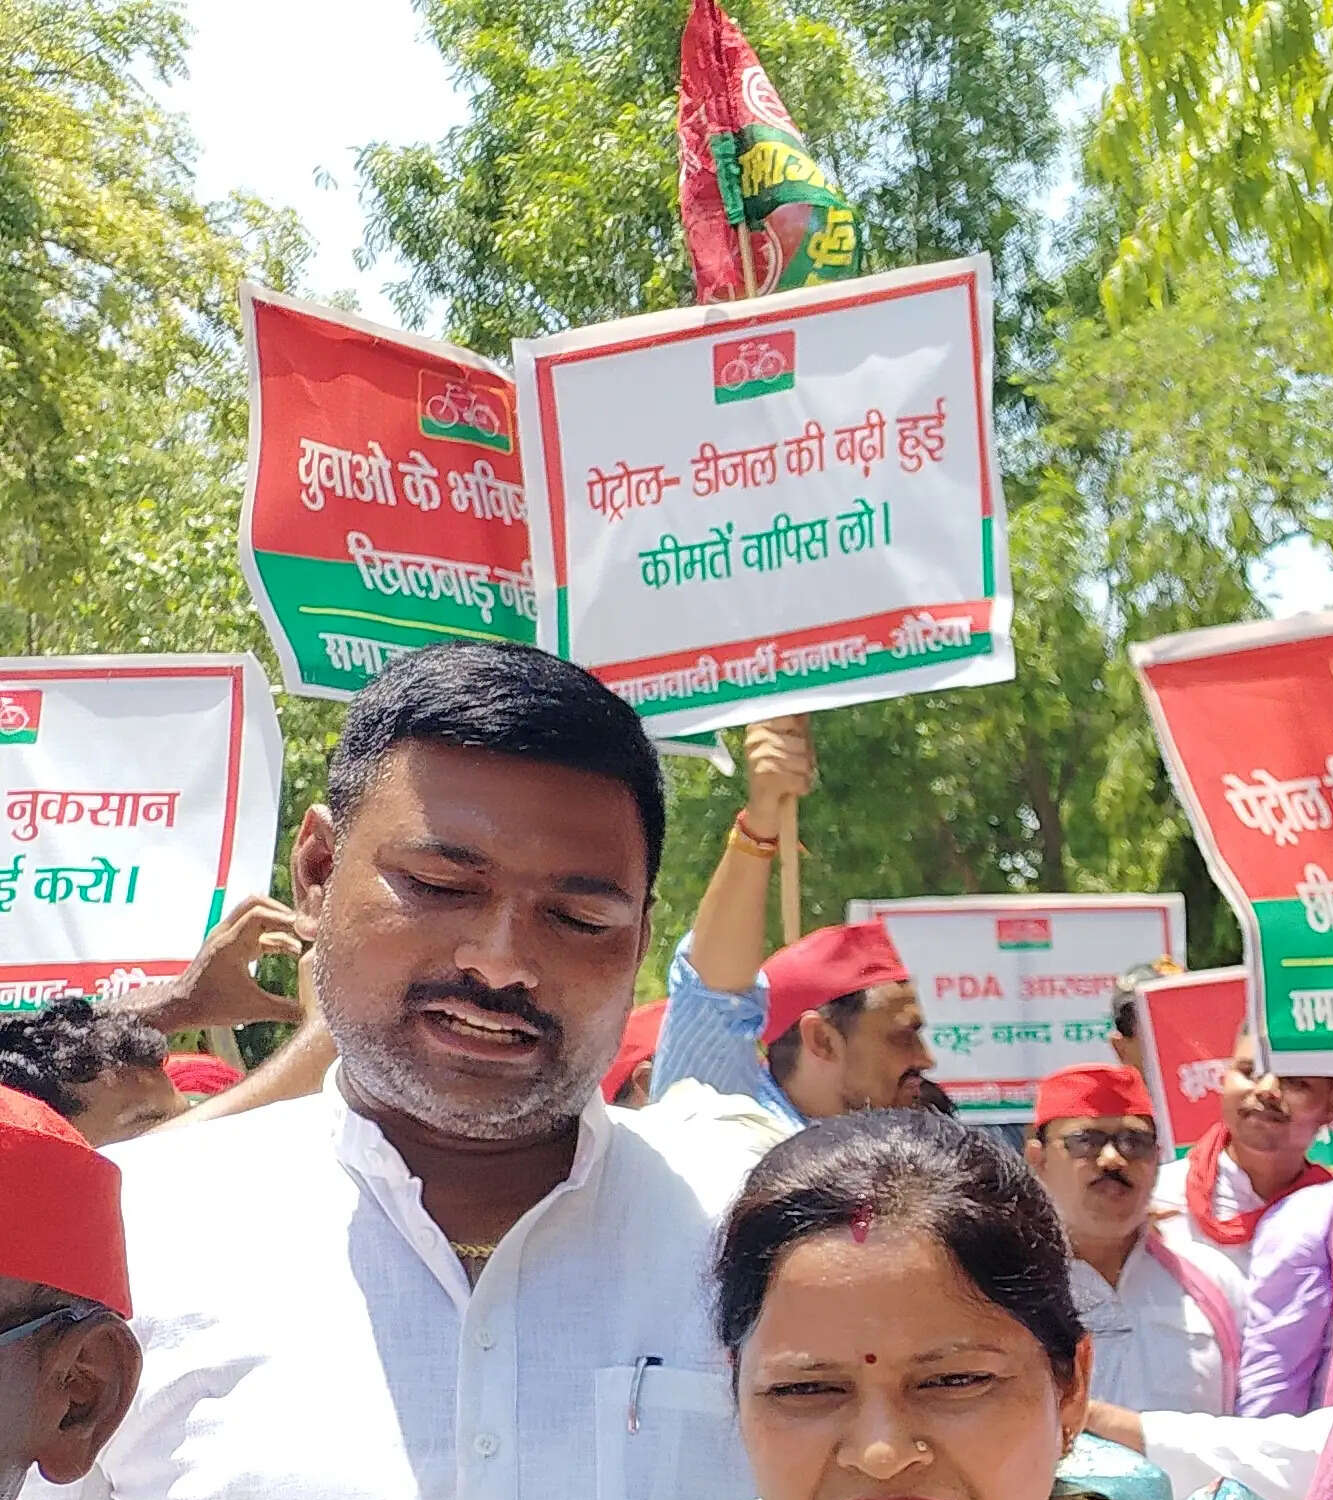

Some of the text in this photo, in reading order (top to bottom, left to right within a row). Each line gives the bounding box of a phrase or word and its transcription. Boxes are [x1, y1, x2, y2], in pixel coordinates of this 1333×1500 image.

[691, 442, 779, 498] डीजल
[784, 420, 826, 478] की
[895, 396, 946, 473] हुई
[398, 449, 440, 511] के
[638, 521, 735, 590] कीमतें
[740, 512, 830, 574] वापिस
[7, 790, 182, 842] नुकसान
[934, 974, 1004, 1000] PDA
